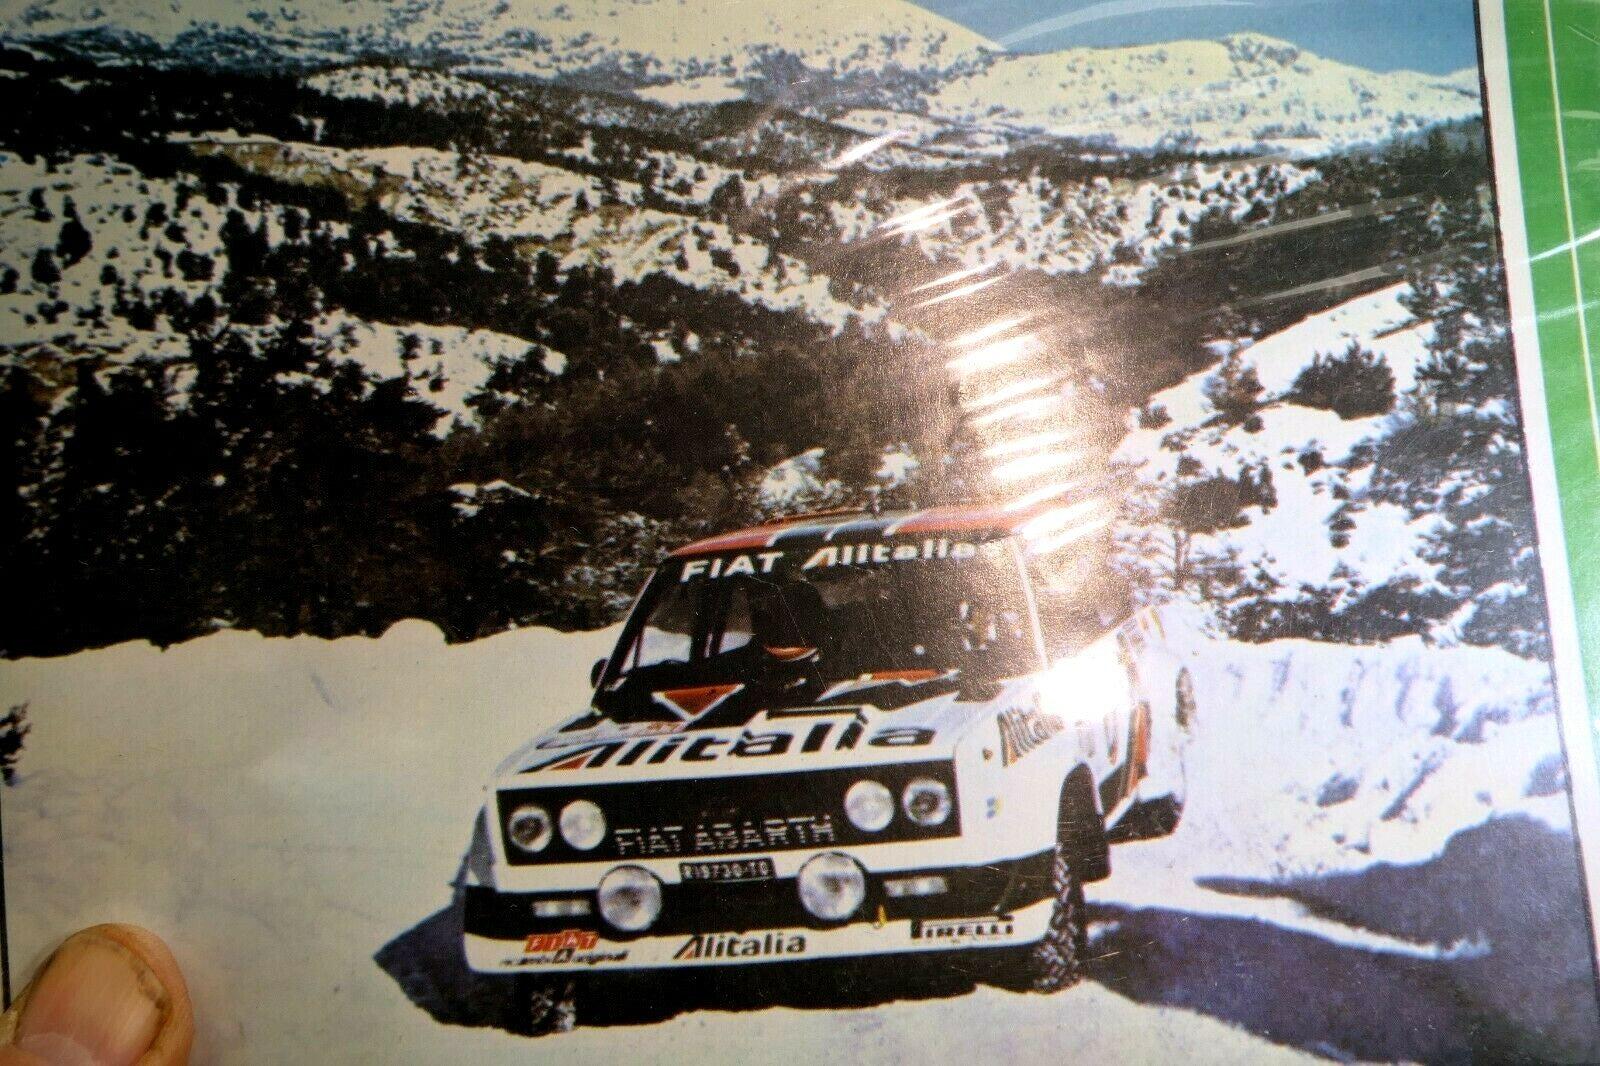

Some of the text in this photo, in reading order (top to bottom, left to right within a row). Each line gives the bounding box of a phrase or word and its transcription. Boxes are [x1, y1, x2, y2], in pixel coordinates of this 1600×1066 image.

[681, 539, 976, 583] FIAT Alitalia
[519, 713, 935, 774] Alitalia
[614, 813, 834, 854] FIAT ABARTH
[672, 931, 806, 960] Alitalia
[910, 915, 1015, 939] PIRELLI
